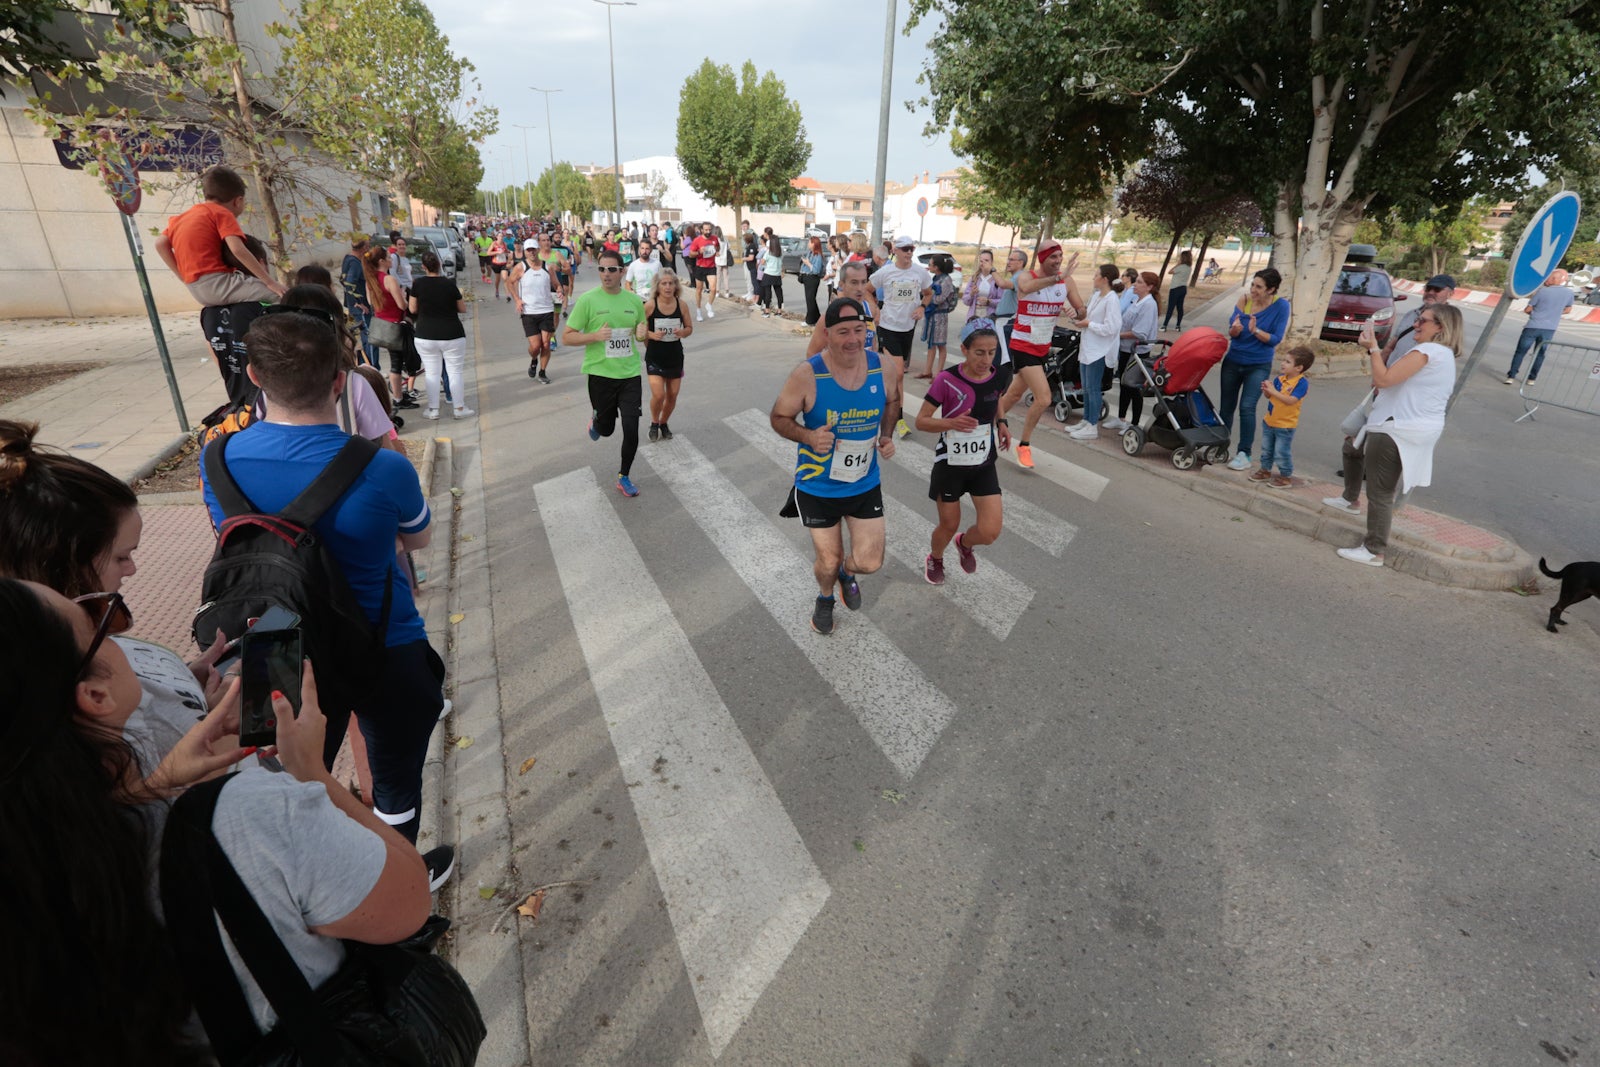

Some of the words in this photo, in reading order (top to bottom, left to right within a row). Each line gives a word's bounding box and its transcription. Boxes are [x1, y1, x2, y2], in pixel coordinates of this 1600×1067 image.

[169, 138, 187, 149] DE
[897, 289, 912, 297] 269
[609, 338, 630, 350] 3002
[841, 407, 880, 419] olimpo
[953, 440, 987, 454] 3104
[844, 452, 868, 467] 614
